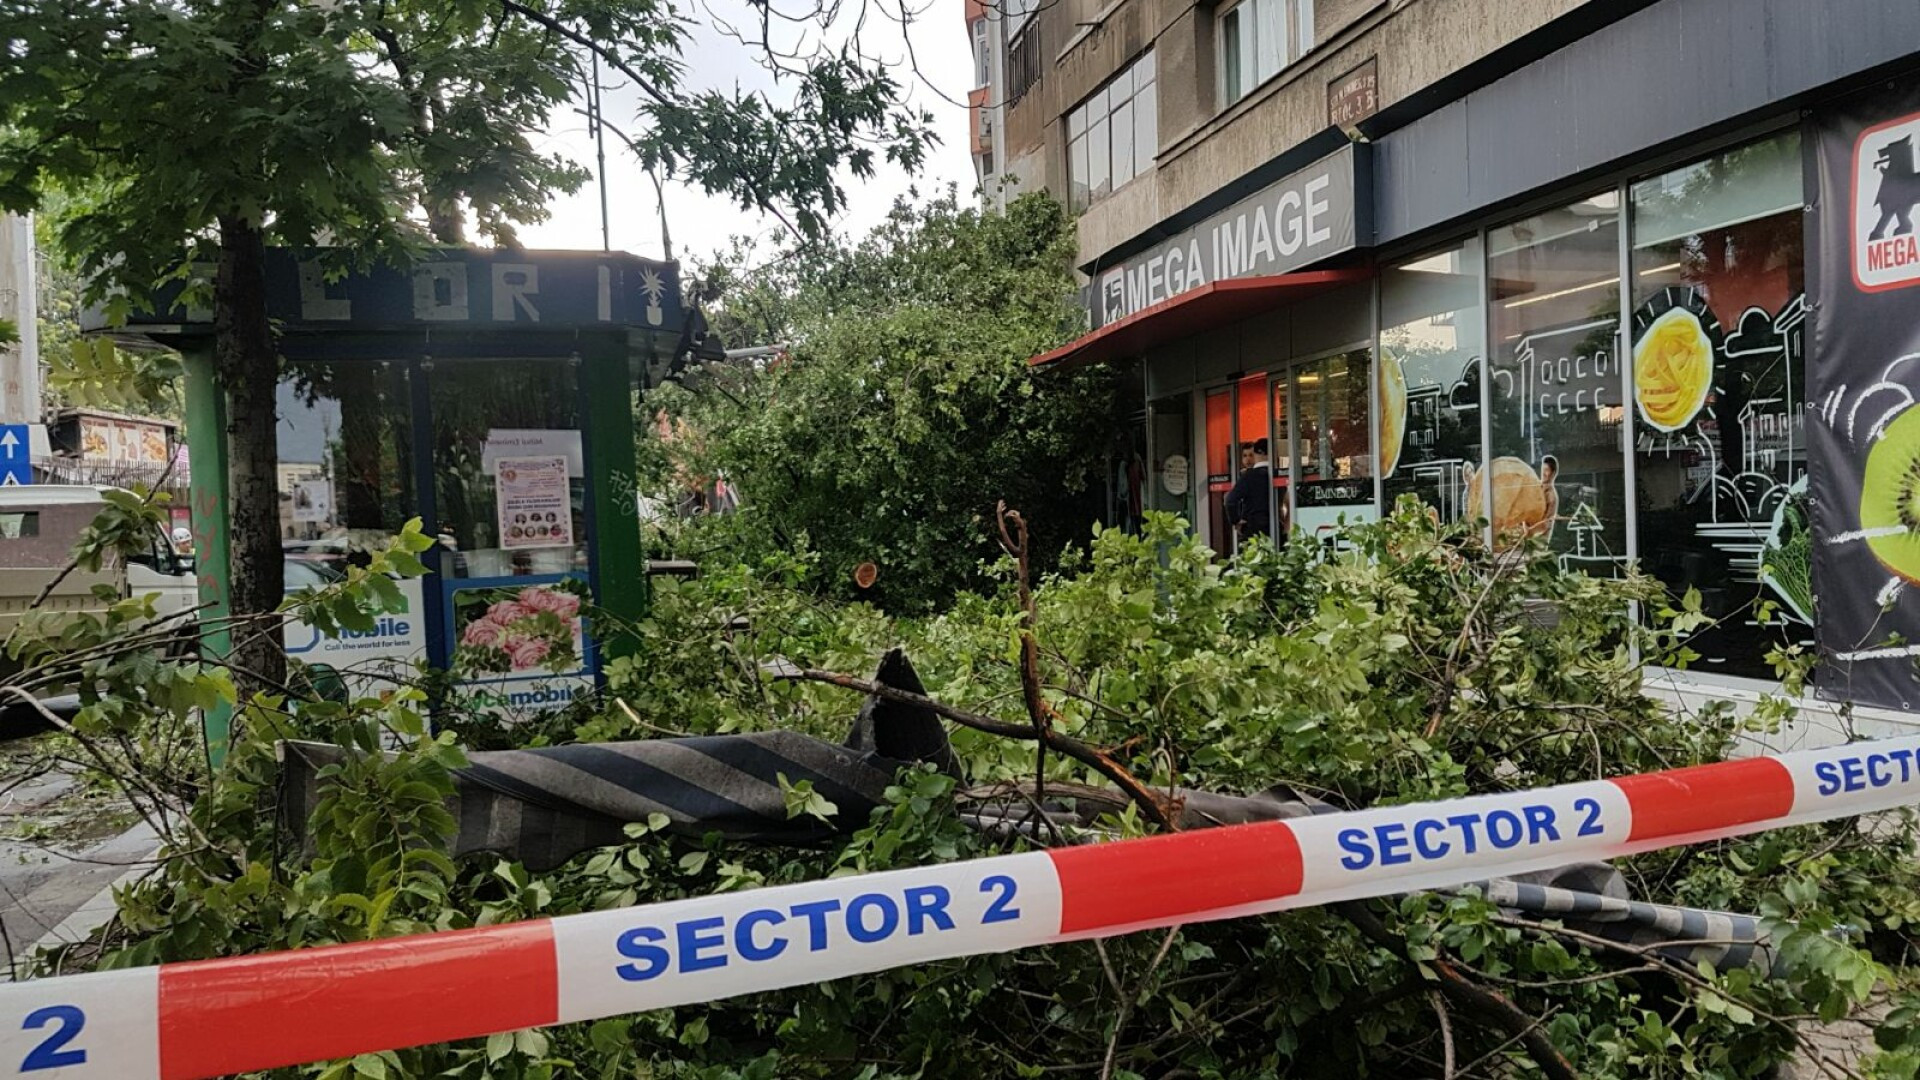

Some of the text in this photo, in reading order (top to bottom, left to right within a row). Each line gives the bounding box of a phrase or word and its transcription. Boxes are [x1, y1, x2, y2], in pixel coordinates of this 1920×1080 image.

[1127, 173, 1331, 316] MEGA IMAGE
[1867, 235, 1919, 272] MEGA
[357, 640, 381, 649] world
[1815, 747, 1920, 797] SECT
[1337, 798, 1604, 871] SECTOR 2
[615, 875, 1021, 982] SECTOR 2
[20, 1004, 87, 1072] 2
